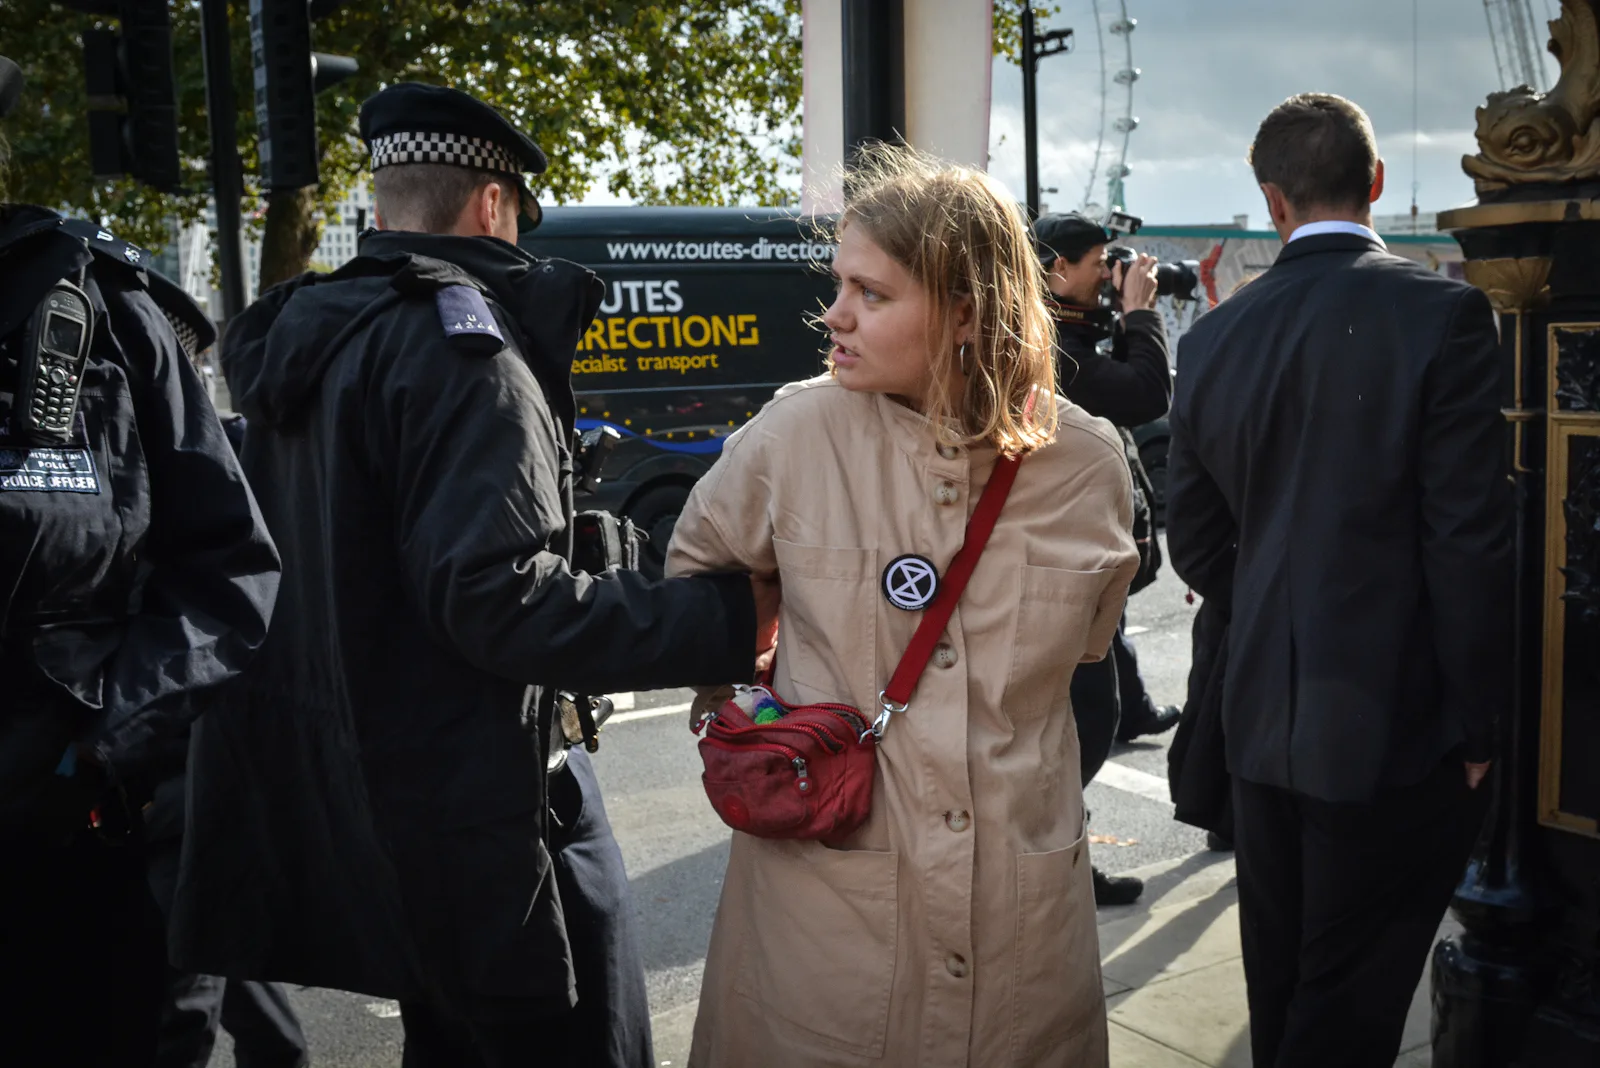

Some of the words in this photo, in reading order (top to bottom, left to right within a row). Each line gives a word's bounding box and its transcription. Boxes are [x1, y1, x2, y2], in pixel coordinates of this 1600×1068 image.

[466, 313, 477, 322] U
[636, 353, 719, 374] transport
[38, 461, 77, 469] POLICE
[0, 474, 46, 488] POLICE
[47, 476, 97, 489] OFFICER
